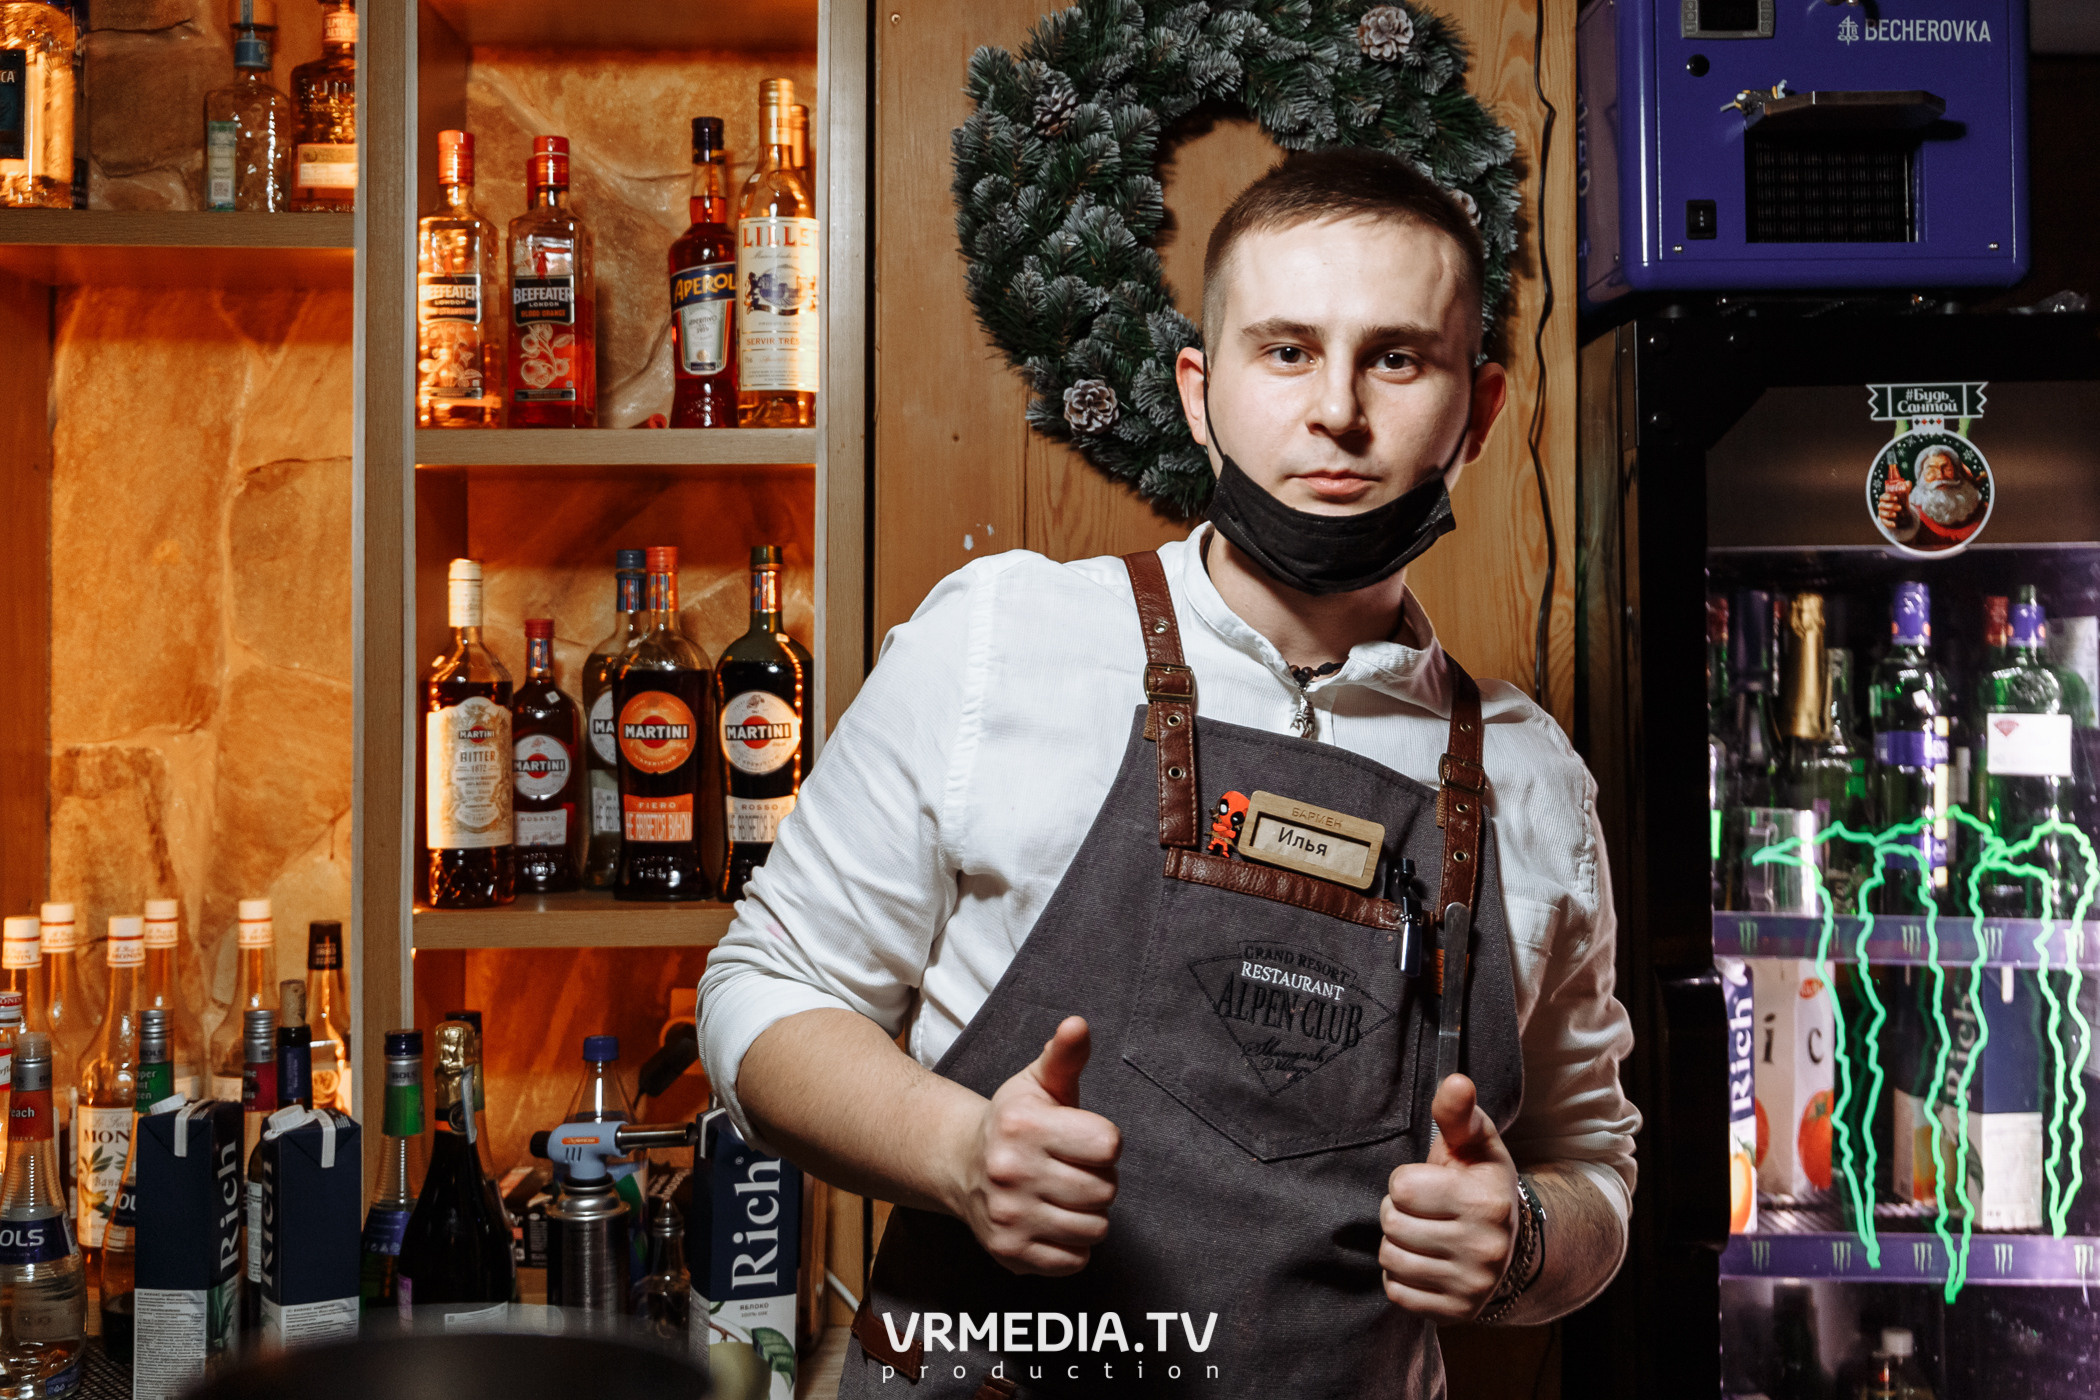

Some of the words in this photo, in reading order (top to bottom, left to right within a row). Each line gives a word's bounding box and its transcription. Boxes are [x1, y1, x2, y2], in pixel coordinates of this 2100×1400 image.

[1864, 19, 1991, 42] BECHEROVKA
[513, 286, 574, 304] BEEFEATER
[674, 273, 736, 303] APEROL
[746, 337, 775, 346] SERVIR
[1905, 387, 1950, 403] #Будь
[1897, 399, 1958, 414] Сантой
[459, 729, 495, 740] MARTINI
[625, 725, 689, 739] MARTINI
[726, 724, 790, 740] MARTINI
[460, 750, 496, 763] BITTER
[513, 760, 565, 772] MARTINI
[741, 803, 779, 811] ROSSO
[1291, 807, 1344, 829] БАРМЕН
[1278, 826, 1328, 856] Илья
[1244, 945, 1294, 964] GRAND
[1297, 953, 1349, 985] RESORT
[1241, 961, 1345, 1000] RESTAURANT
[1215, 971, 1299, 1032] ALPEN
[1301, 999, 1363, 1048] CLUB
[1729, 996, 1753, 1114] Rich
[217, 1140, 239, 1274] Rich
[732, 1157, 782, 1291] Rich
[739, 1302, 769, 1311] ЯБЛОКО
